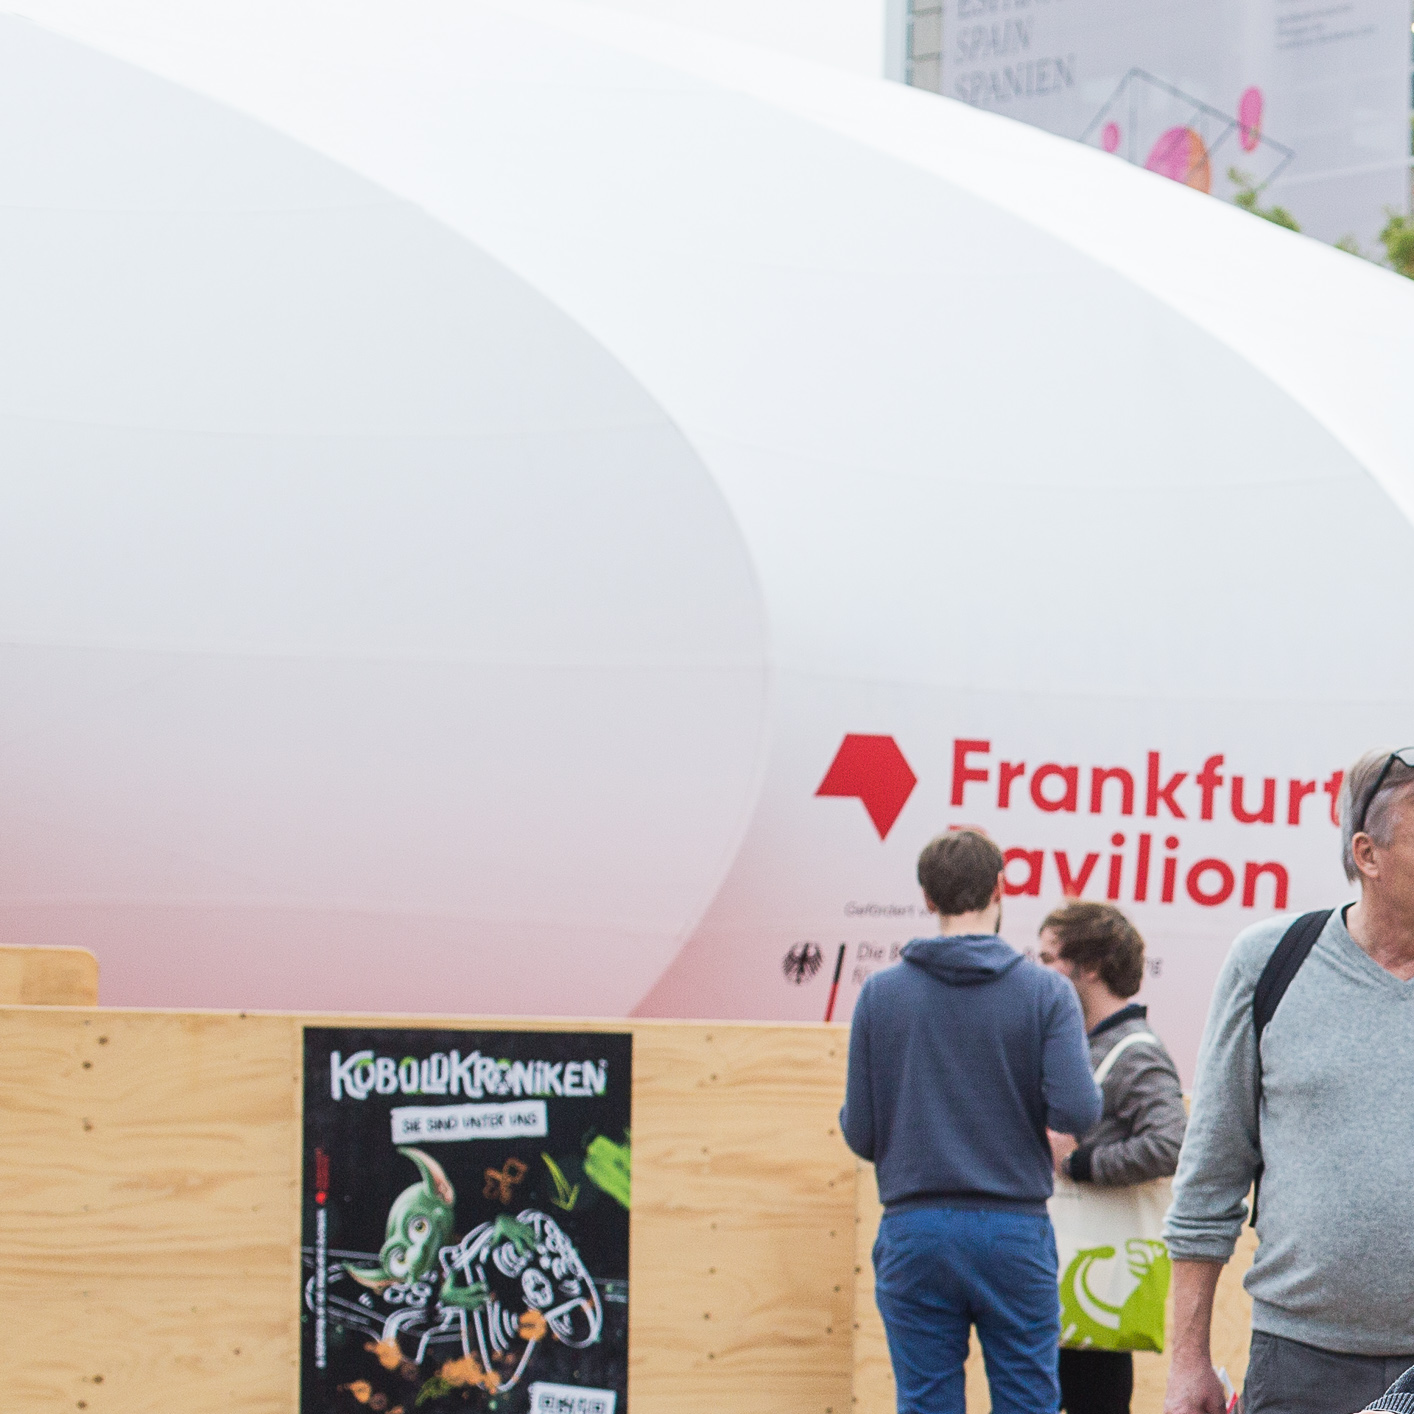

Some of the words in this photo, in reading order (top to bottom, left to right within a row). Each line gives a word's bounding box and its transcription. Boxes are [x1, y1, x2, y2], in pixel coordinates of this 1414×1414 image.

[954, 14, 1034, 65] SPAIN
[953, 52, 1076, 105] SPANIEN
[950, 738, 1344, 828] Frankfurt
[946, 824, 1290, 911] avilion
[426, 1114, 459, 1132] SIND
